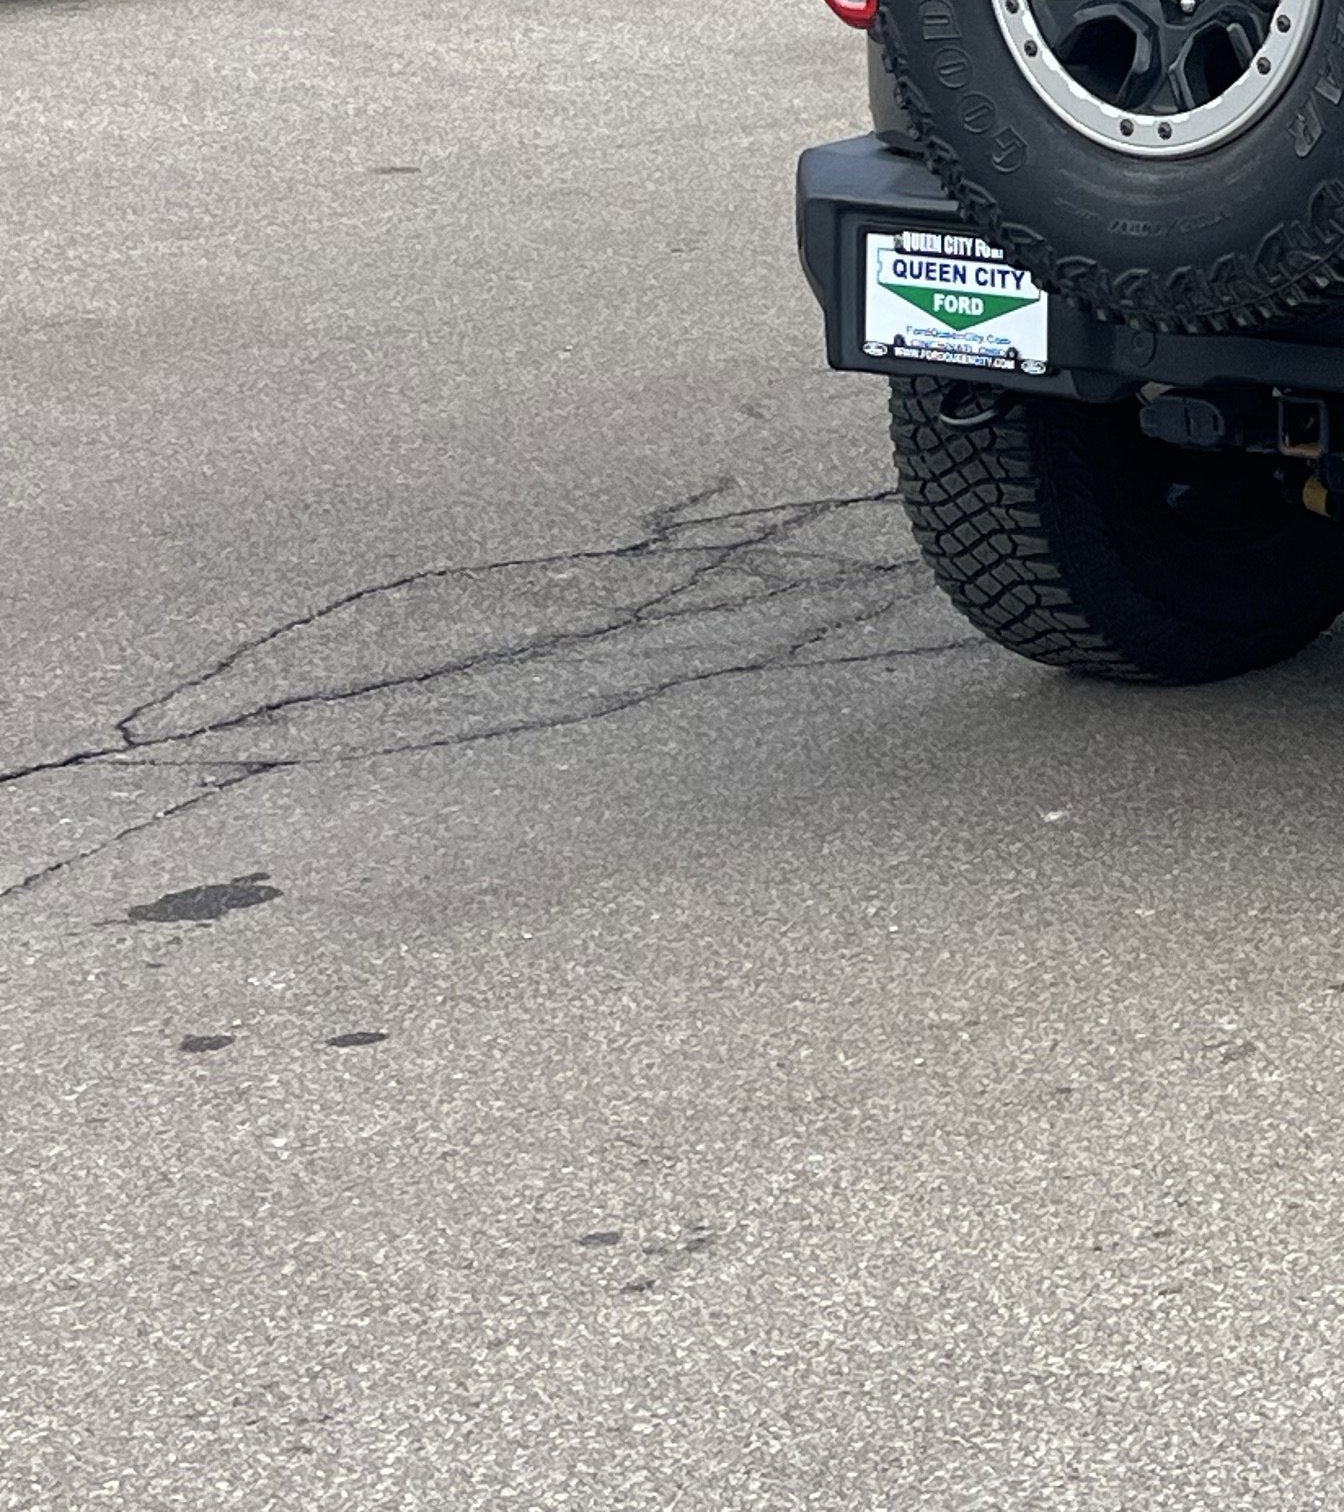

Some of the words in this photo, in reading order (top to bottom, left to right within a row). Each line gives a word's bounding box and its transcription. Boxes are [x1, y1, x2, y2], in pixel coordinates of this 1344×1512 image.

[902, 231, 942, 253] QUEEN
[944, 235, 975, 257] CITY
[892, 258, 967, 285] QUEEN
[975, 266, 1025, 290] CITY
[933, 292, 985, 316] FORD
